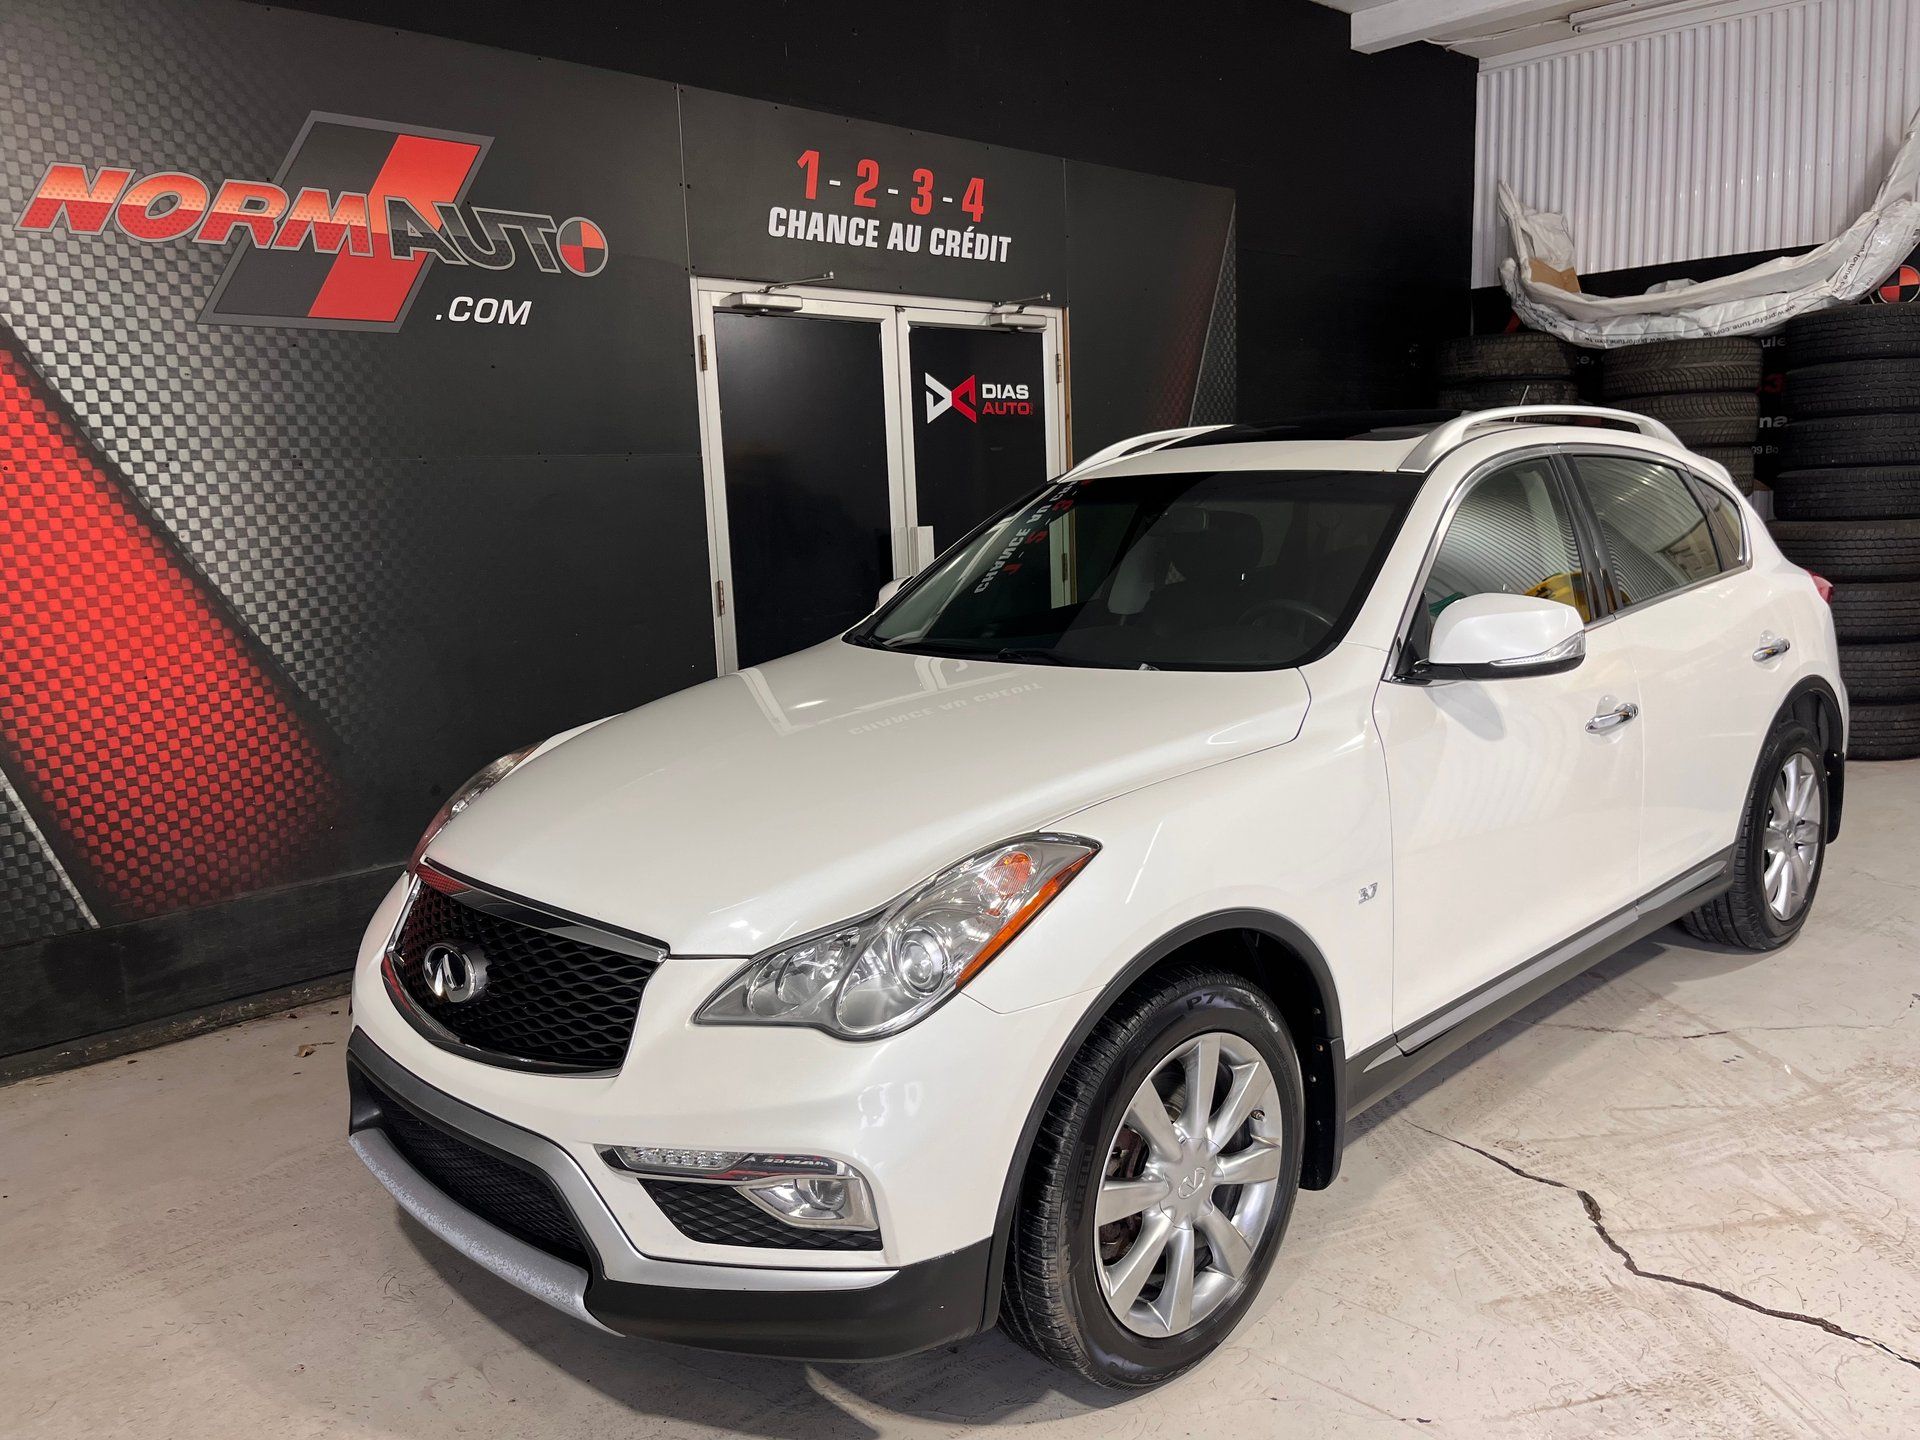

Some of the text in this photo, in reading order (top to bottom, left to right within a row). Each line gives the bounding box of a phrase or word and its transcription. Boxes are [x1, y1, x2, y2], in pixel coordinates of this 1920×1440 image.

[767, 206, 1012, 263] CHANCE AU CRÉDIT
[981, 383, 1029, 400] DIAS
[981, 401, 1031, 416] AUTO
